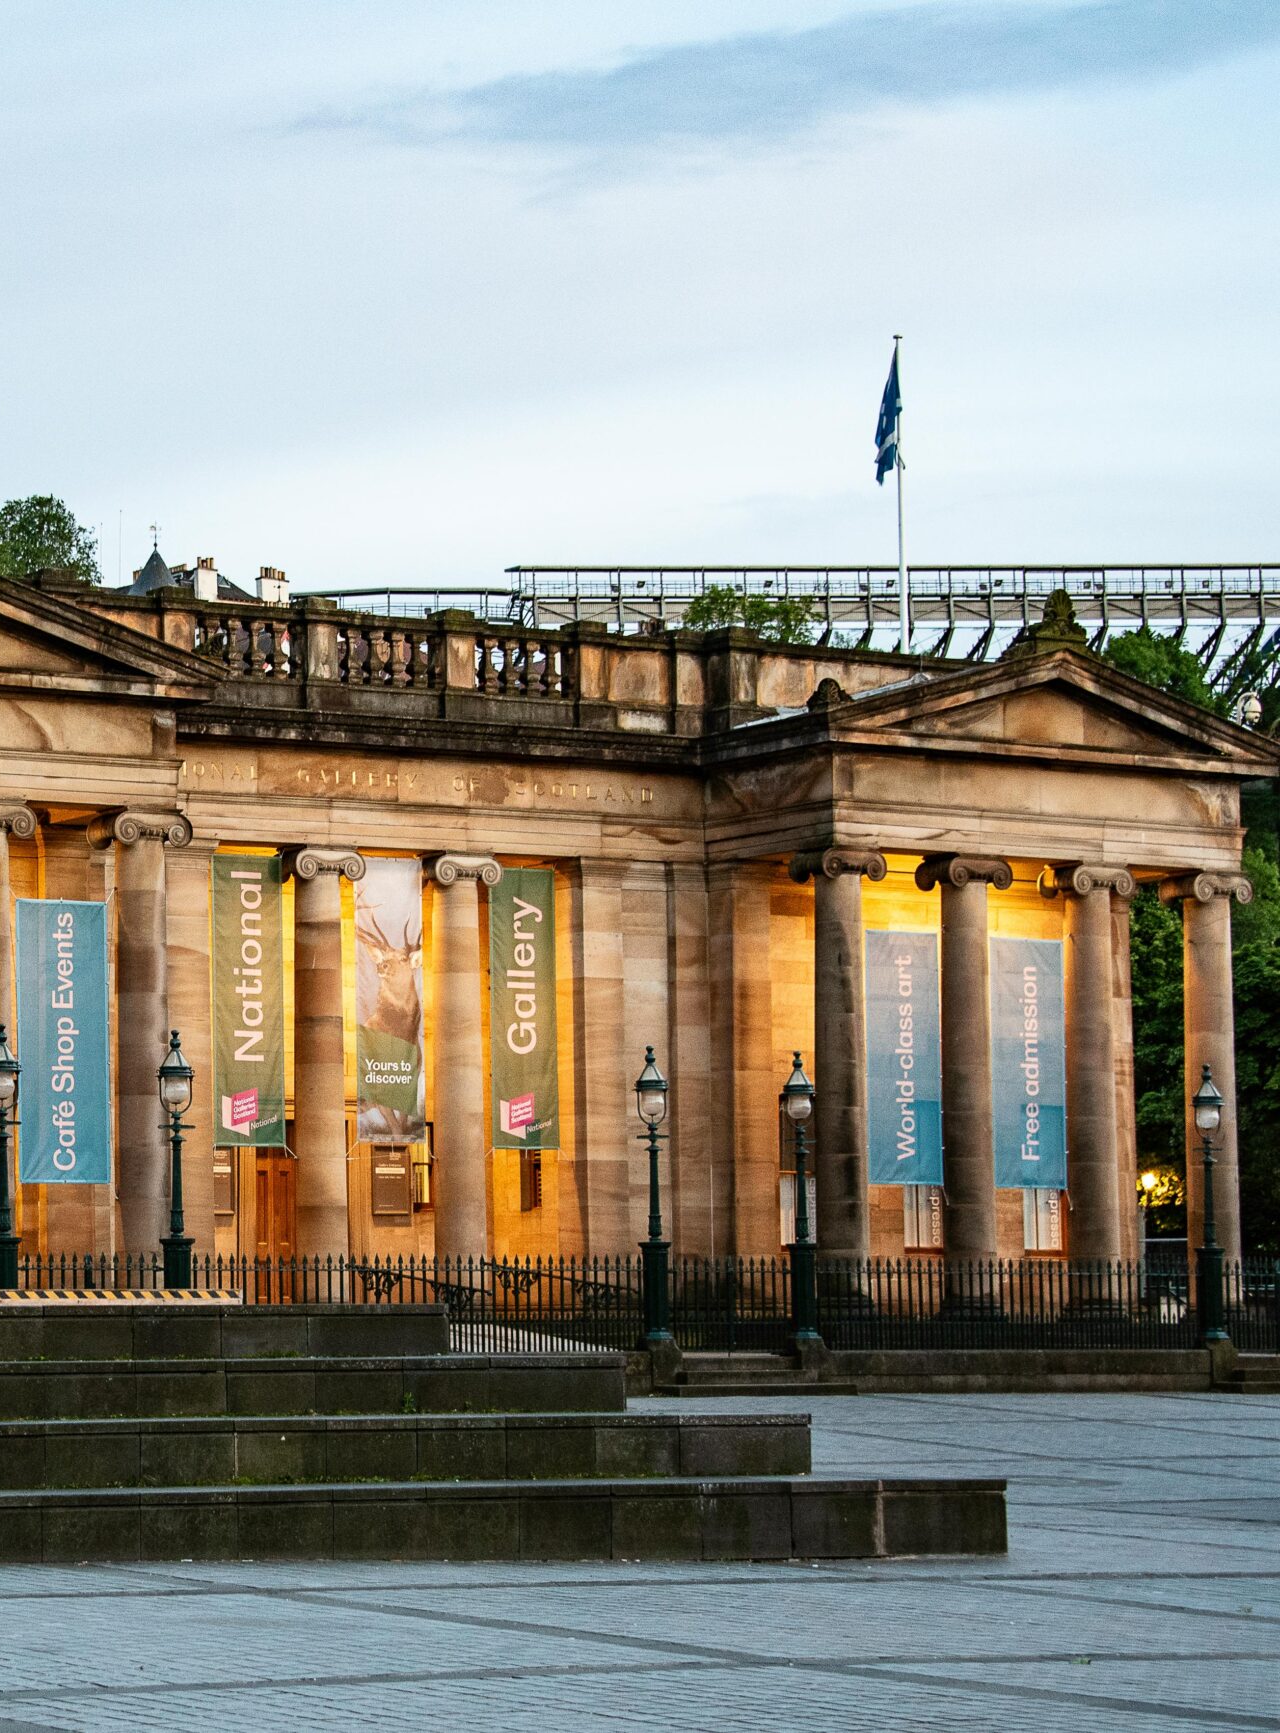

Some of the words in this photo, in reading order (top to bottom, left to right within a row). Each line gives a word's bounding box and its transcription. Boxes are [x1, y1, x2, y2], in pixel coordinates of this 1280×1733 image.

[182, 761, 258, 781] IONAL
[297, 768, 424, 789] GALLERY
[452, 775, 482, 793] OF
[51, 911, 74, 1009] Events
[233, 871, 265, 1062] National
[506, 895, 543, 1055] Gallery
[894, 954, 913, 997] art
[51, 1017, 80, 1094] Shop
[1018, 965, 1040, 1096] admission
[364, 1058, 398, 1072] Yours
[399, 1059, 412, 1072] to
[364, 1071, 413, 1085] discover
[895, 1003, 916, 1161] World-class
[233, 1095, 255, 1106] National
[233, 1102, 256, 1113] Galleries
[233, 1109, 256, 1120] Scotland
[250, 1114, 278, 1131] National
[526, 1118, 552, 1134] National
[52, 1103, 77, 1172] Café
[1020, 1104, 1041, 1162] Free
[928, 1186, 941, 1245] spresso
[1048, 1189, 1060, 1248] spresso
